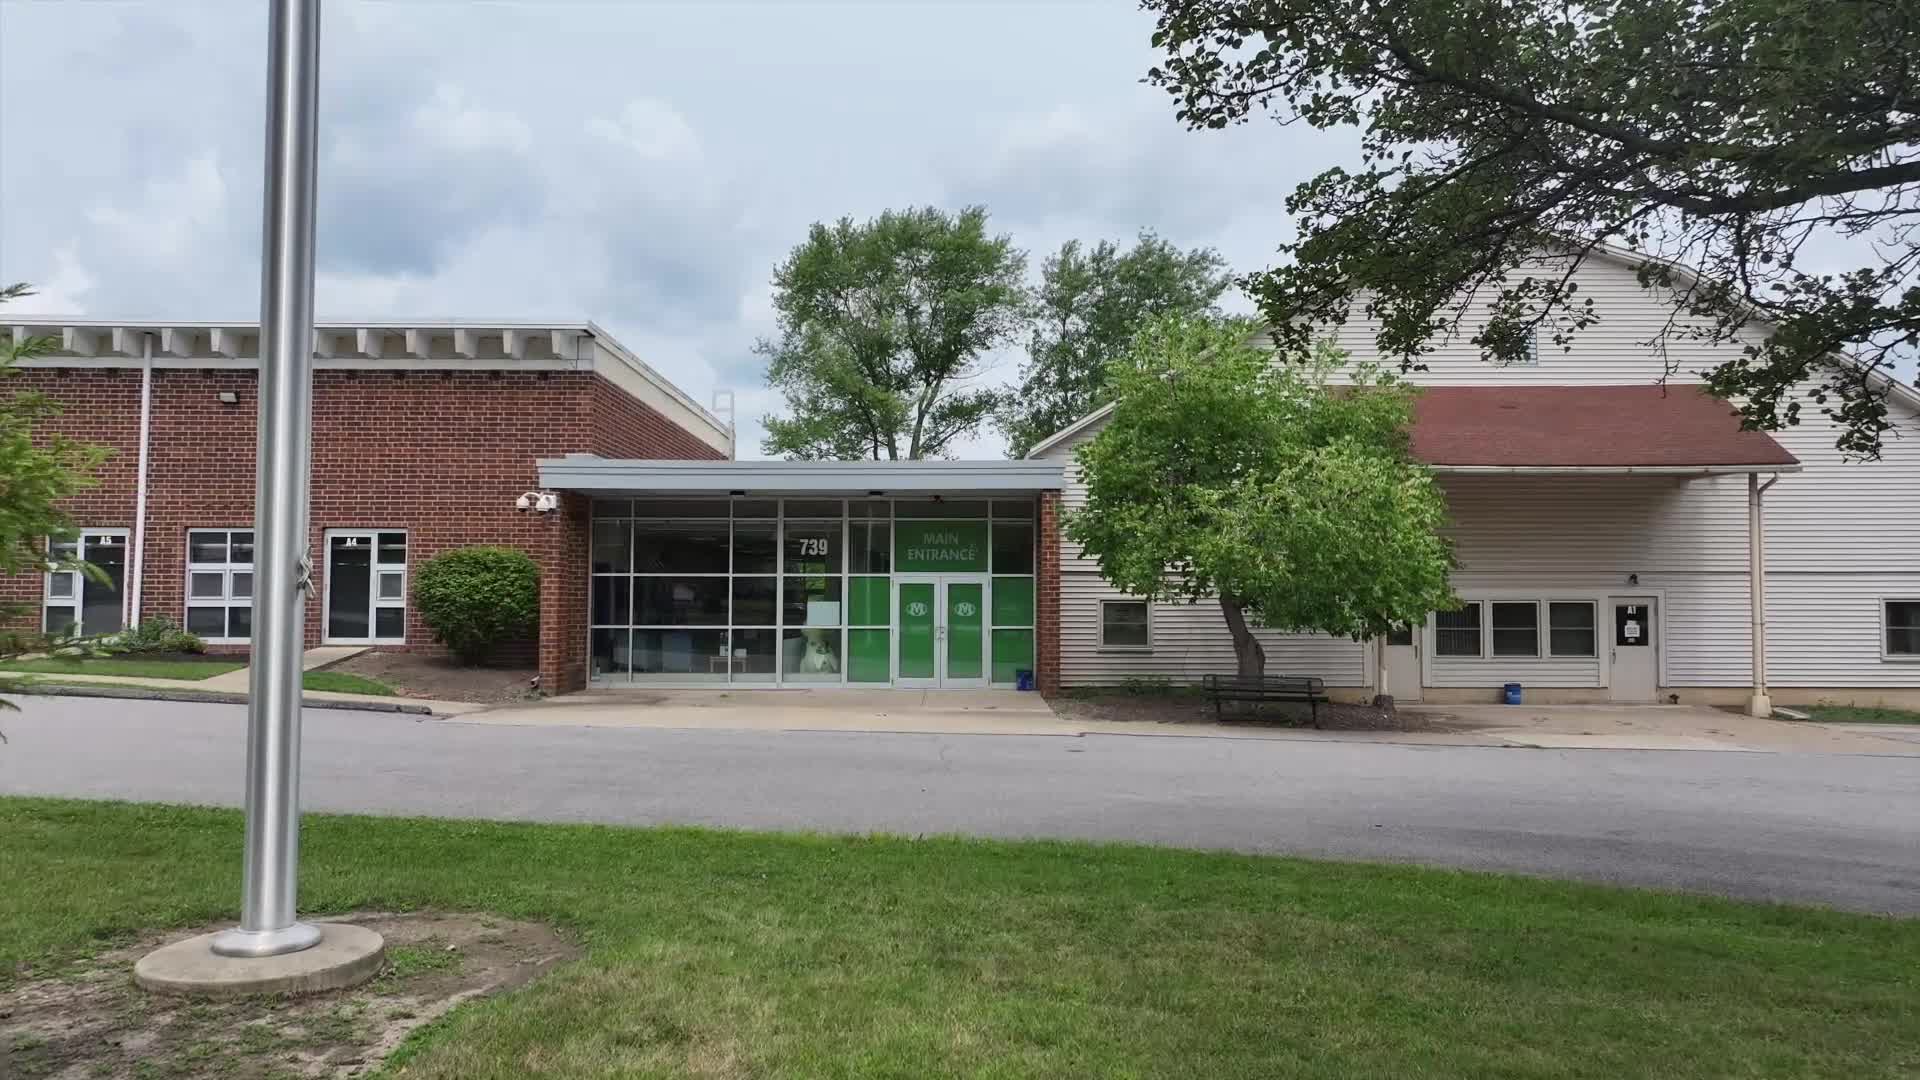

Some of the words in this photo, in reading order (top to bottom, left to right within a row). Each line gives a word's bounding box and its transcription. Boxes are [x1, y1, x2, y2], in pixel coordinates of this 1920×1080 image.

[100, 536, 112, 545] A5
[346, 537, 357, 547] A4
[923, 533, 959, 545] MAIN
[800, 538, 828, 555] 739
[907, 548, 976, 561] ENTRANCE
[1627, 605, 1637, 615] A1
